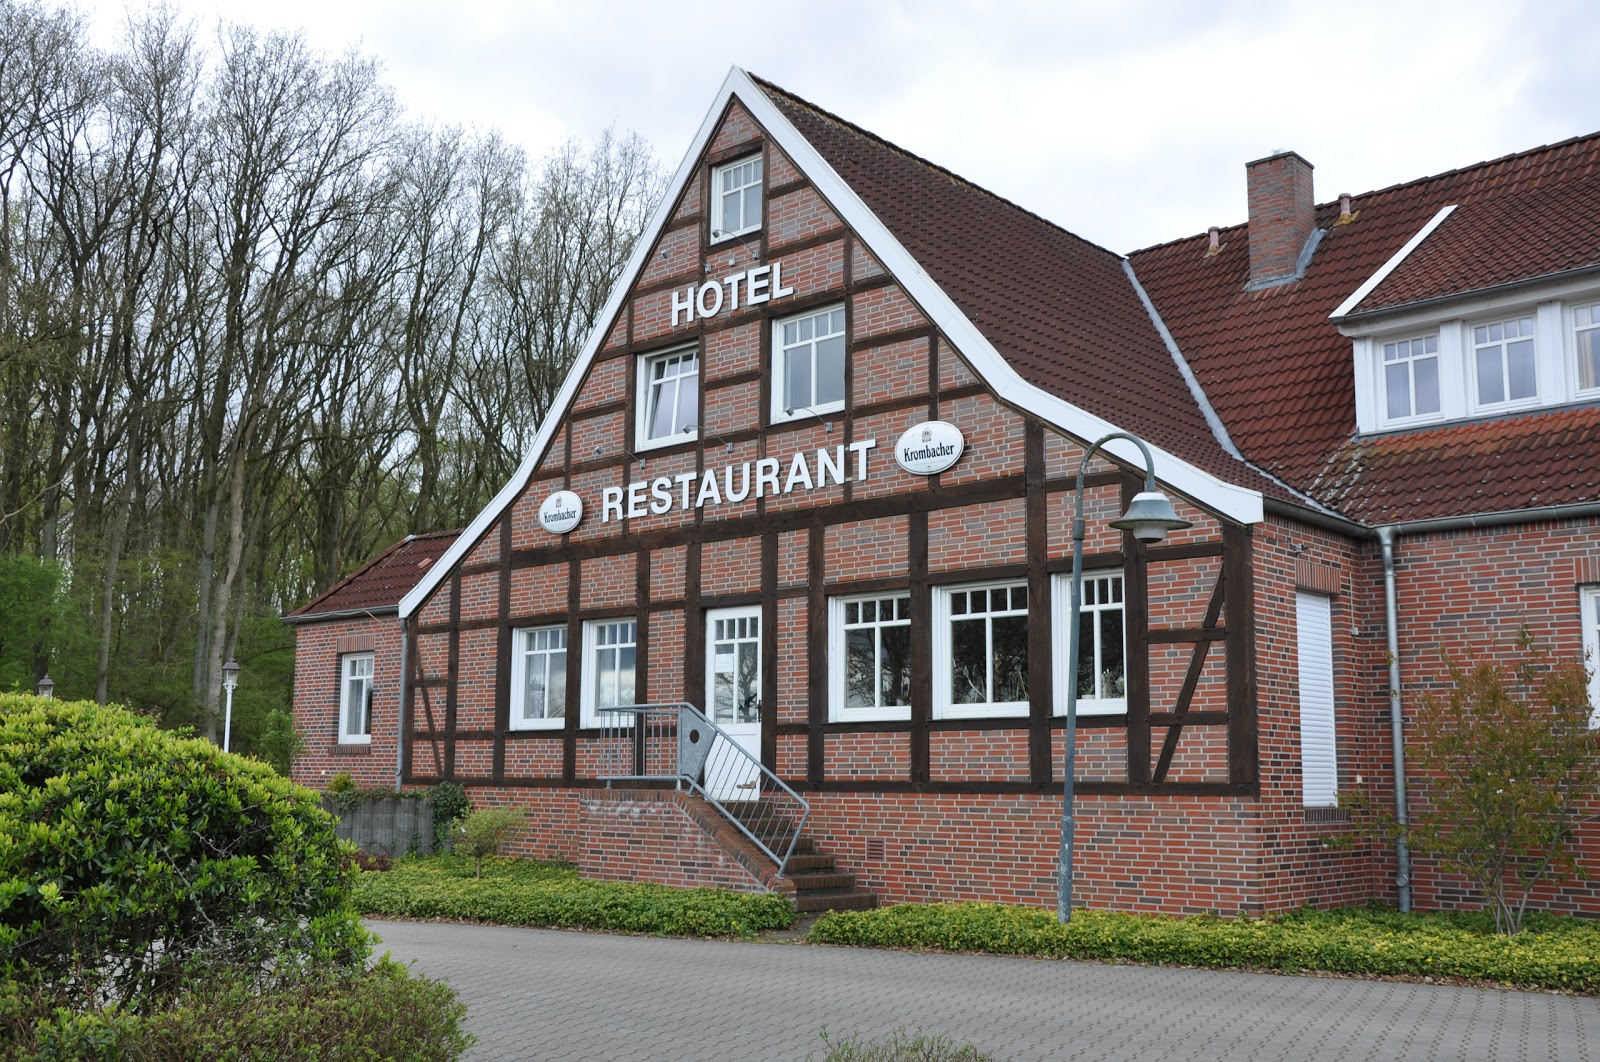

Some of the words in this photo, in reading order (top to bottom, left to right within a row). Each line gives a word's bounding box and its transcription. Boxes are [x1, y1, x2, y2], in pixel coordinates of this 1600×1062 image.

[671, 262, 794, 327] HOTEL
[904, 442, 954, 462] Krombacher
[602, 438, 876, 523] RESTAURANT
[544, 508, 576, 523] Krombacher
